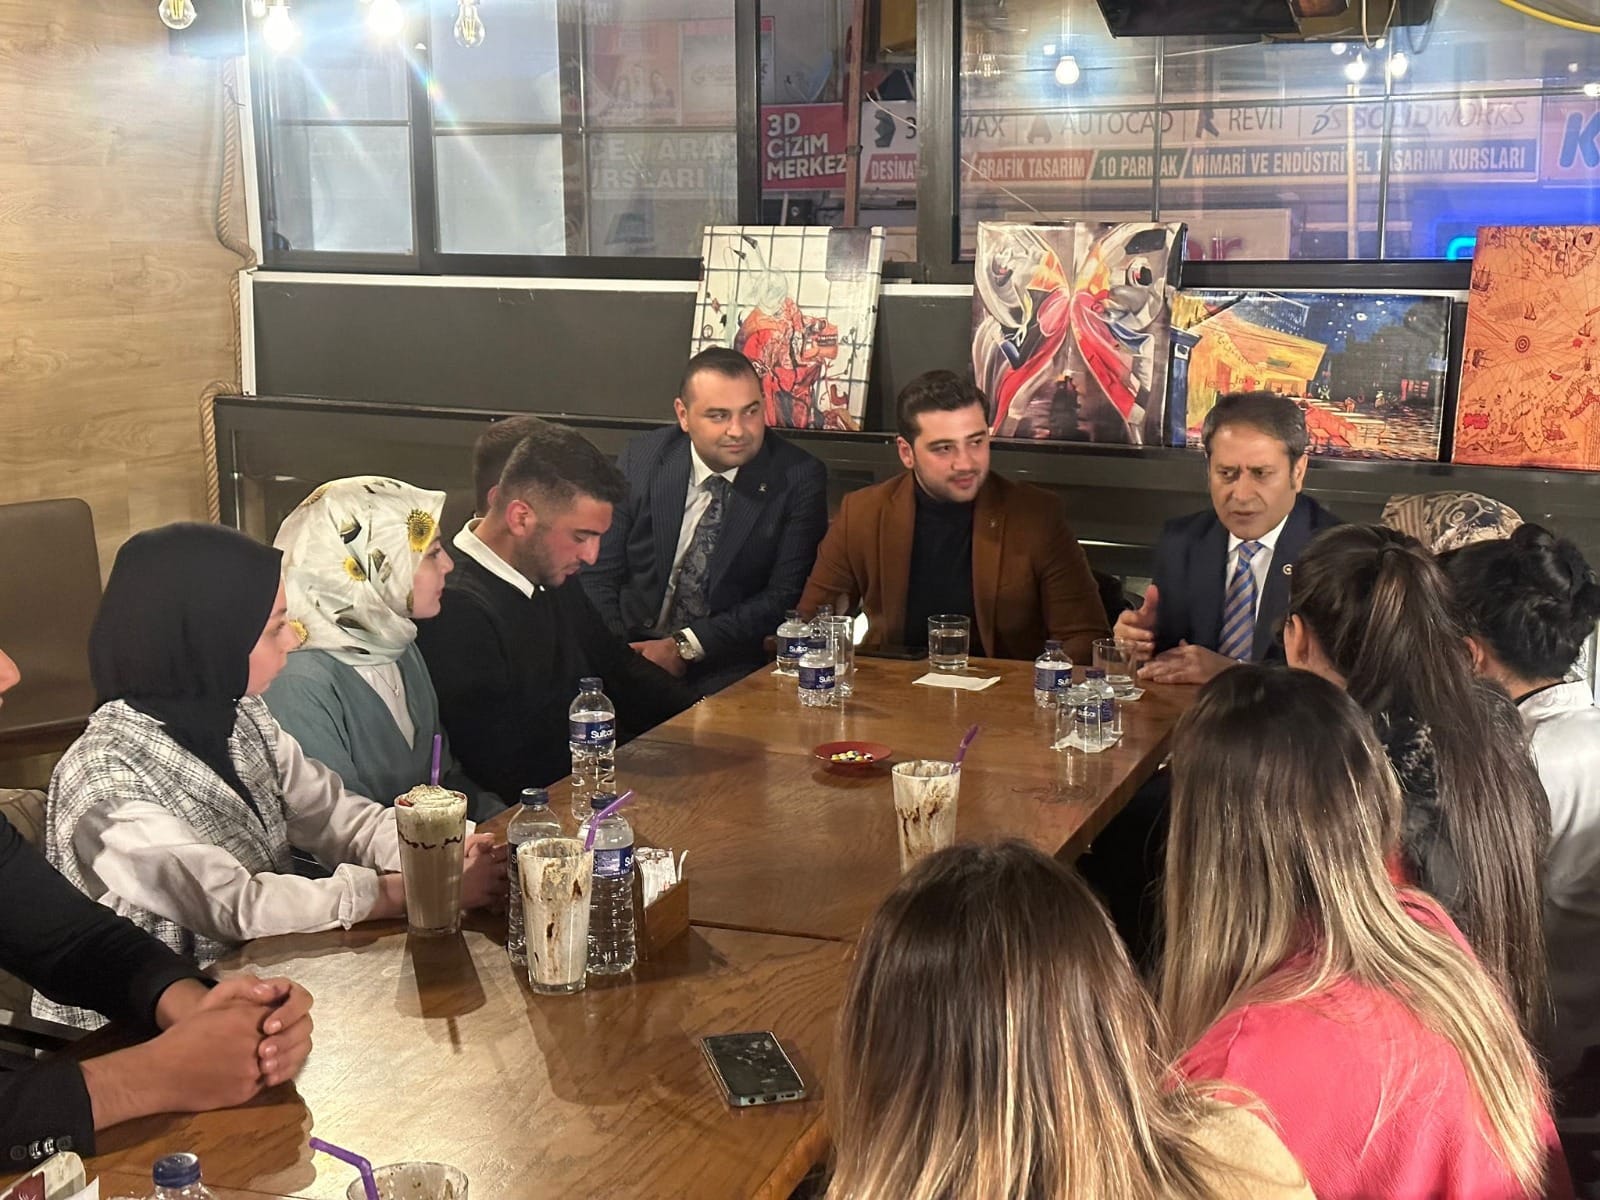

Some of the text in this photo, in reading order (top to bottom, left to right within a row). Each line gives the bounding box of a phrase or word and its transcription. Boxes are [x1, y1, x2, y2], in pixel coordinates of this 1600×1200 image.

[767, 112, 801, 137] 3D
[1060, 110, 1174, 135] AUTOCAD
[871, 154, 917, 180] DESİNA
[979, 153, 1085, 178] GRAFİK TASARIM
[1100, 157, 1116, 178] 10
[1192, 148, 1246, 176] MİMARİ
[1251, 152, 1269, 173] VE
[1273, 145, 1371, 173] ENDÜSTRİEL
[1449, 146, 1525, 171] KURSLARI
